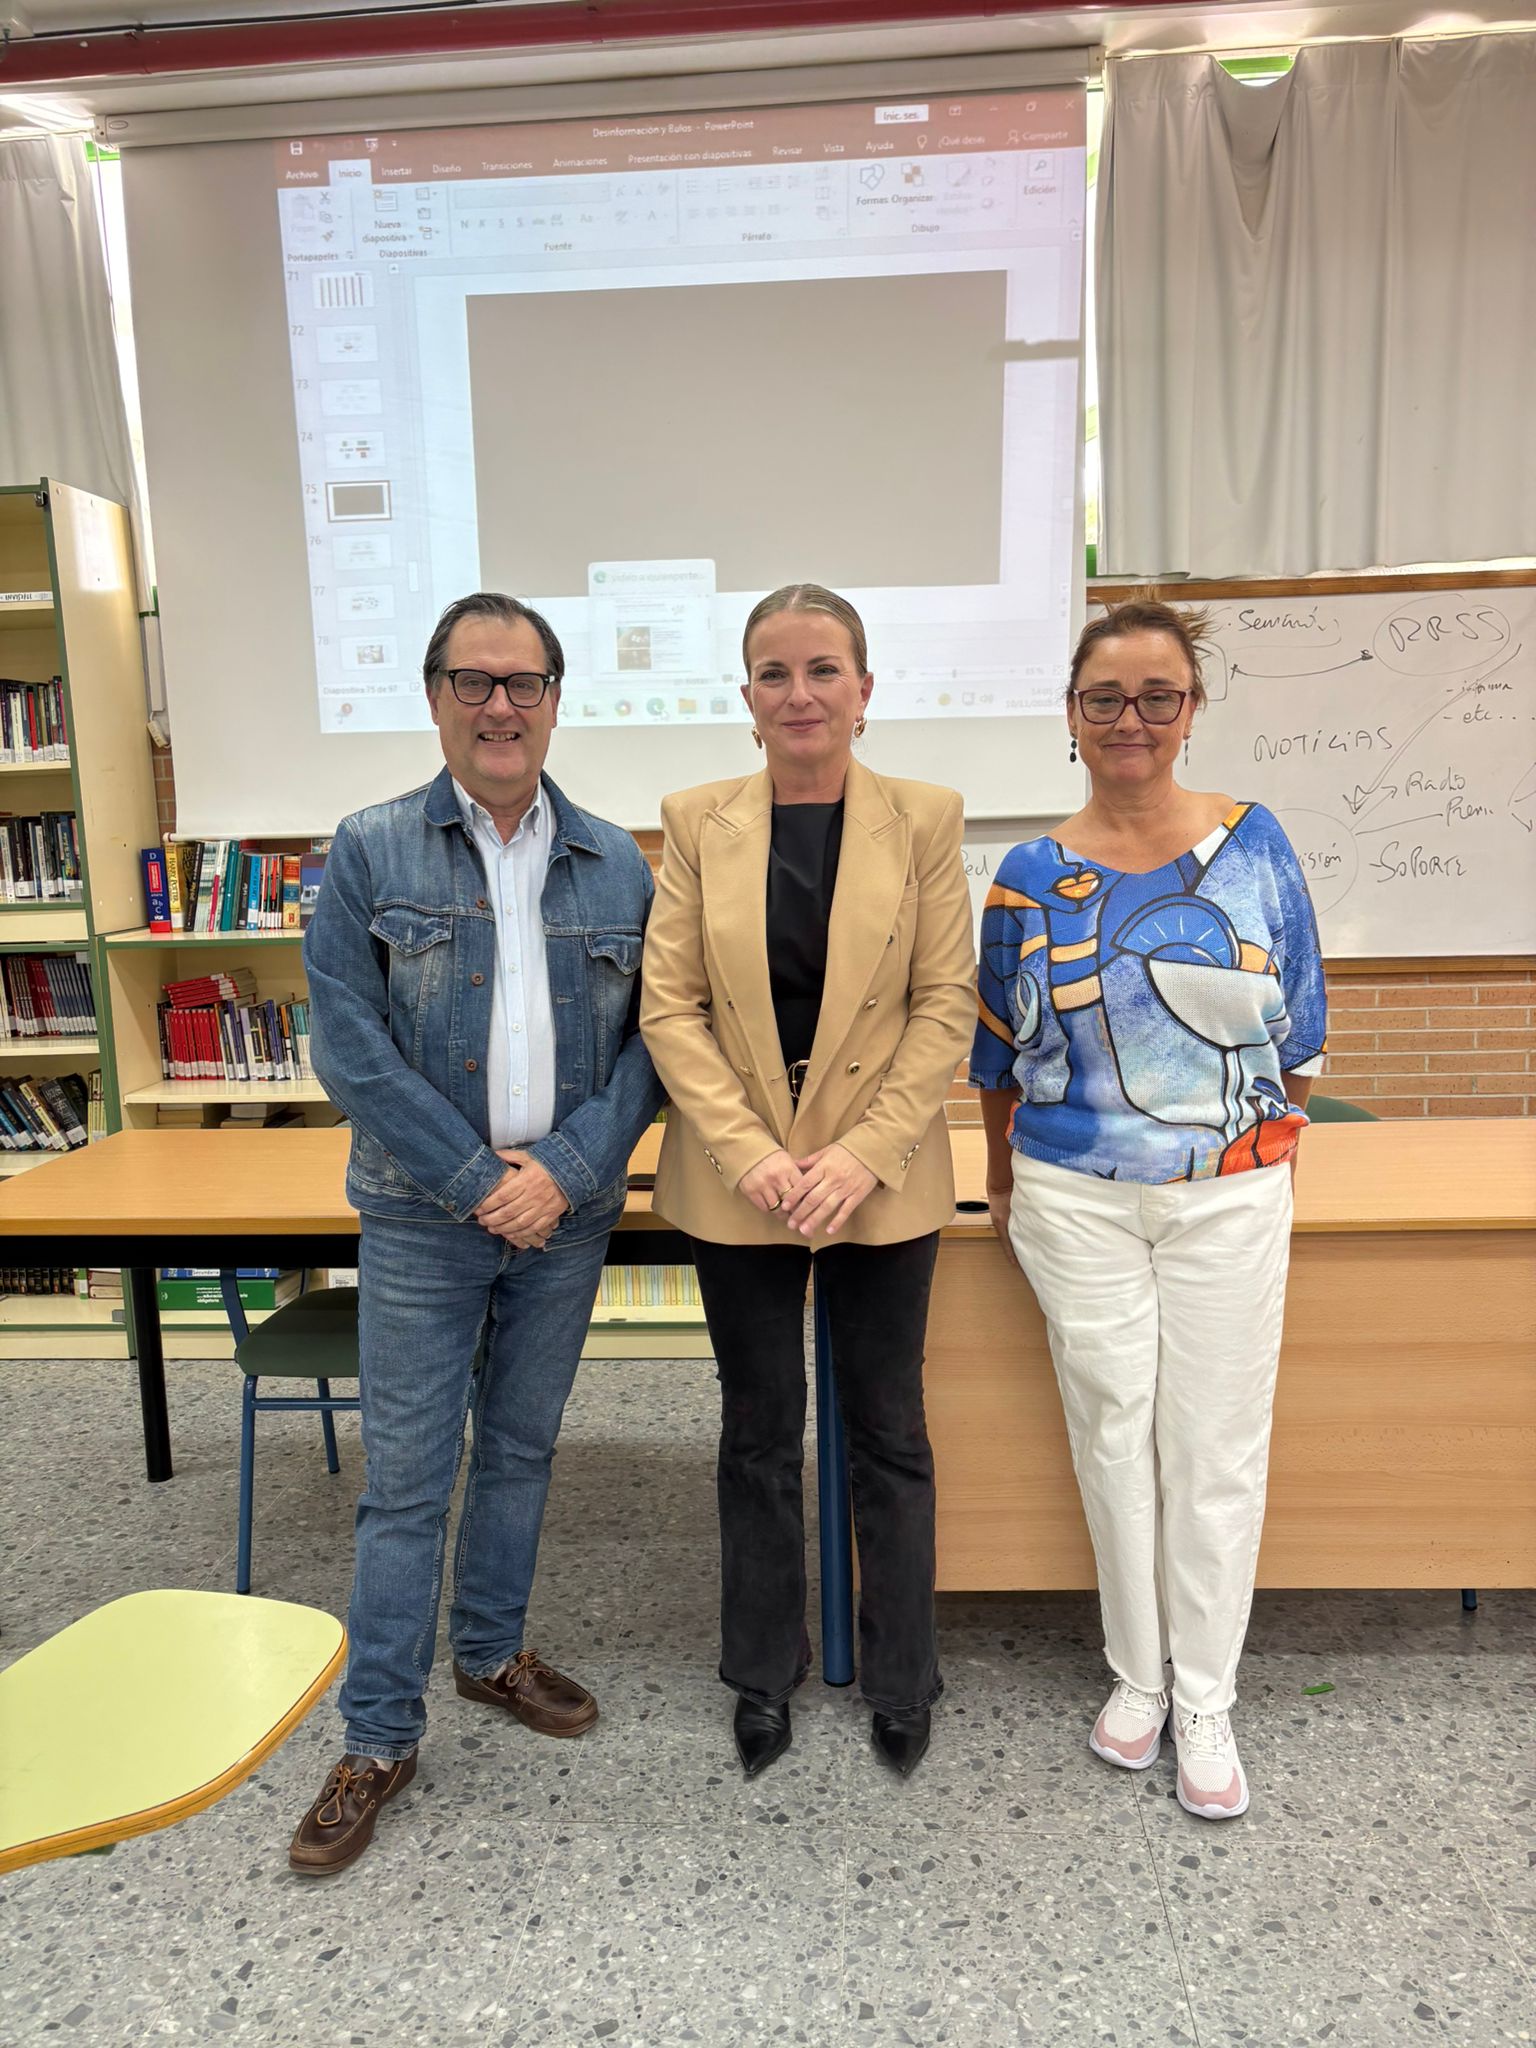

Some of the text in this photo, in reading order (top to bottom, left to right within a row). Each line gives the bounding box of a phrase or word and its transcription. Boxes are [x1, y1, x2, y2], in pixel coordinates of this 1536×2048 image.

[592, 126, 660, 138] Desinformación
[660, 126, 667, 136] y
[668, 123, 693, 134] Bulos
[704, 119, 755, 132] PowerPoint
[1022, 130, 1069, 144] Compartir
[772, 145, 804, 156] Revisar
[823, 143, 845, 153] Vista
[865, 140, 895, 154] Ayuda
[627, 148, 752, 164] Presentación con diapositivas
[481, 161, 534, 172] Transiciones
[552, 157, 608, 168] Animaciones
[338, 168, 363, 178] Inicio
[381, 166, 413, 177] Insertar
[432, 164, 462, 174] Diseño
[286, 171, 319, 181] Archivo
[1023, 184, 1057, 196] Edición
[856, 195, 889, 206] Formas
[891, 193, 934, 206] Organizar
[374, 220, 402, 230] Nueva
[911, 223, 940, 234] Dibujo
[362, 234, 408, 246] diapositiva
[741, 232, 772, 243] Párrafo
[544, 241, 573, 252] Fuente
[287, 249, 339, 263] Portapapeles
[379, 249, 428, 260] Diapositivas
[287, 271, 300, 282] 71
[291, 324, 304, 336] 72
[296, 378, 309, 390] 73
[300, 432, 313, 443] 74
[305, 483, 317, 495] 75
[309, 535, 322, 547] 76
[313, 586, 326, 597] 77
[317, 635, 329, 646] 78
[323, 686, 365, 696] Diapositiva
[168, 857, 180, 903] HARRY POTTER
